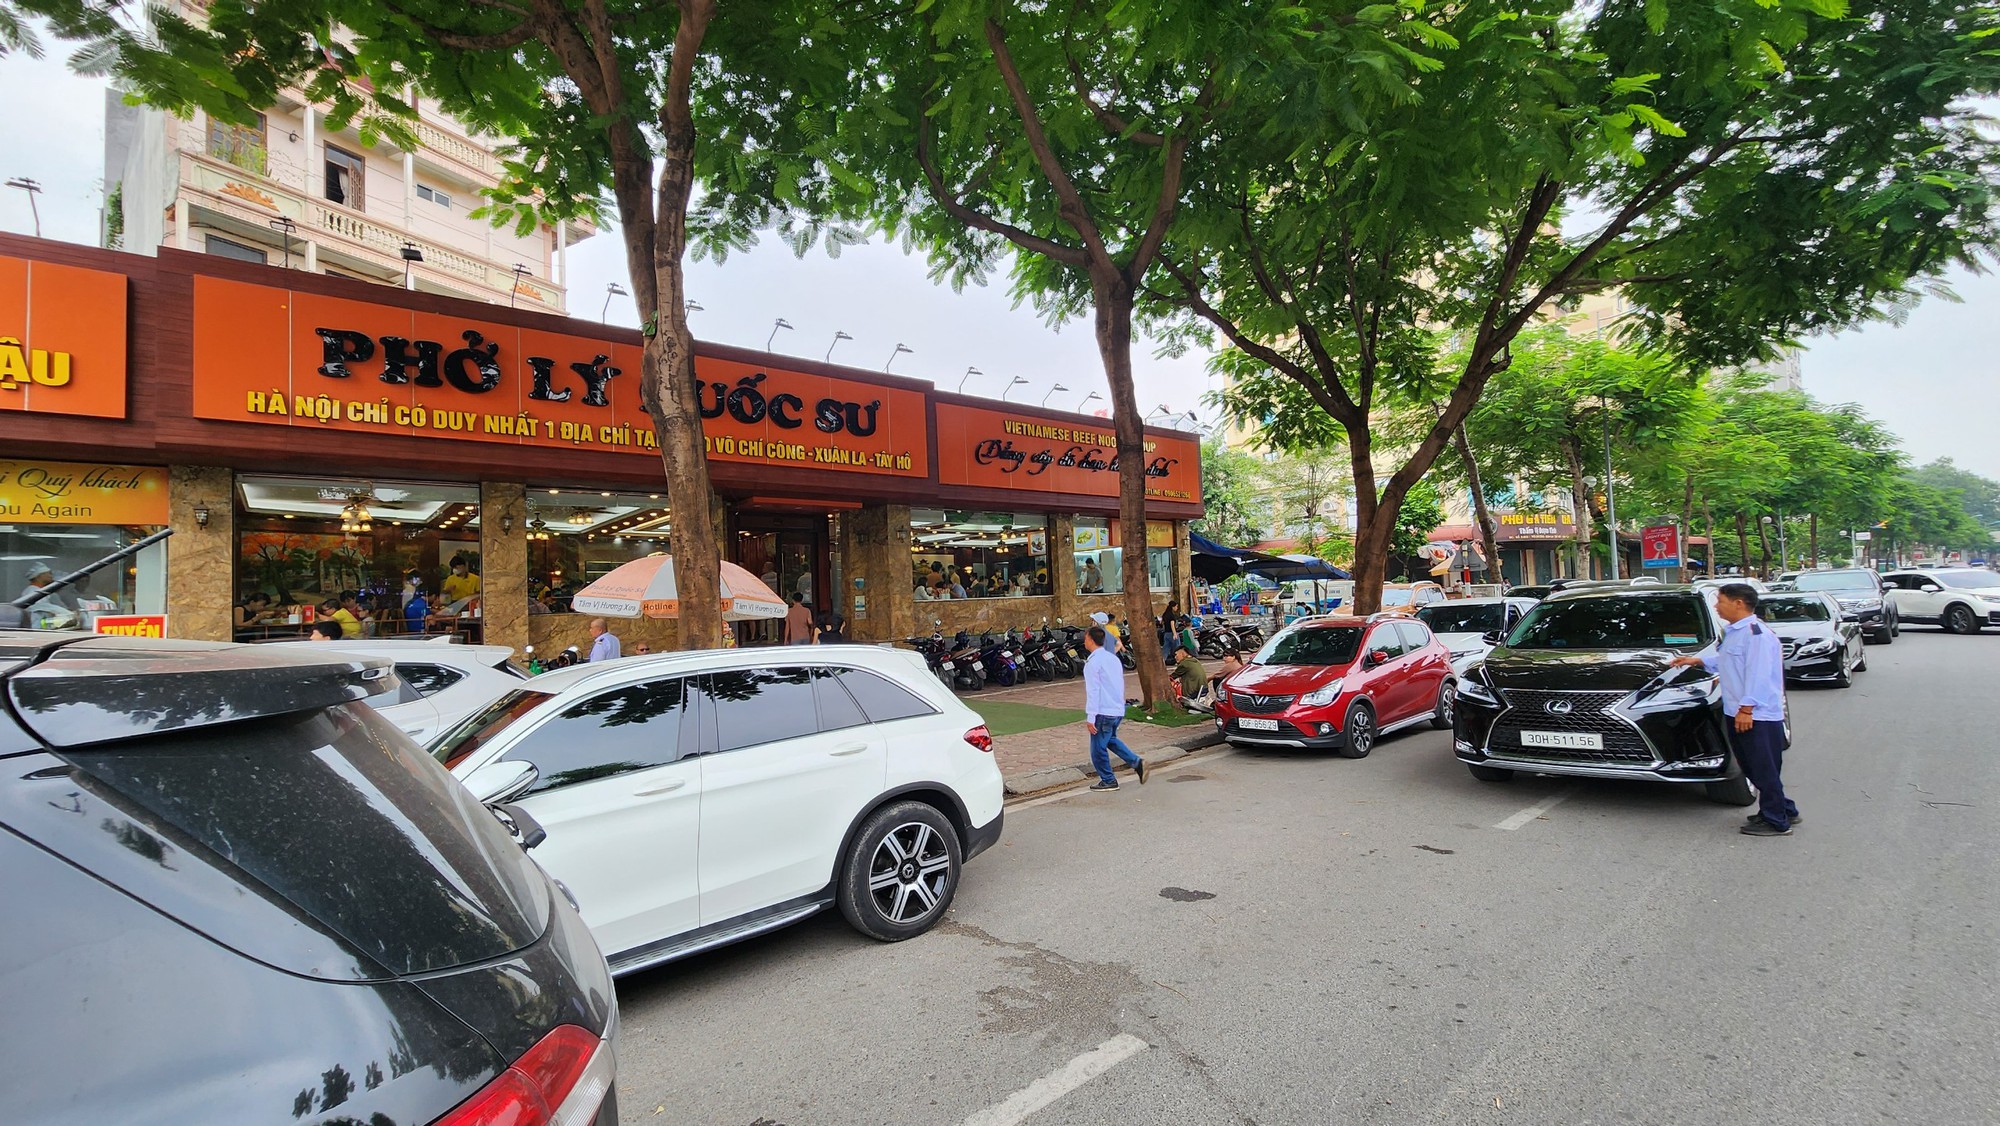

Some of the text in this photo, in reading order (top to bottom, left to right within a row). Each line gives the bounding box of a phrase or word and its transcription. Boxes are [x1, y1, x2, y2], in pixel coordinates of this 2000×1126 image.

[315, 327, 881, 437] PHỞ LÝ UỐC SƯ
[247, 388, 287, 415] HÀ
[295, 394, 340, 424] NỘI
[347, 397, 388, 424] CHỈ
[394, 403, 427, 427] CÓ
[433, 410, 477, 431] DUY
[484, 410, 538, 437] NHẤT
[545, 421, 554, 438] 1
[560, 421, 593, 444] ĐỊA
[600, 422, 630, 445] CHỈ
[715, 435, 735, 454] VÕ
[738, 438, 764, 457] CHÍ
[896, 451, 912, 470] HỒ
[1004, 420, 1070, 441] VIETNAMESE
[1072, 430, 1096, 445] BEEF
[1098, 434, 1117, 448] NOO
[17, 468, 73, 499] Quý
[79, 467, 158, 490] khách
[31, 503, 92, 518] Again
[643, 603, 676, 611] Hotline:
[1527, 733, 1595, 747] 30H-511.56
